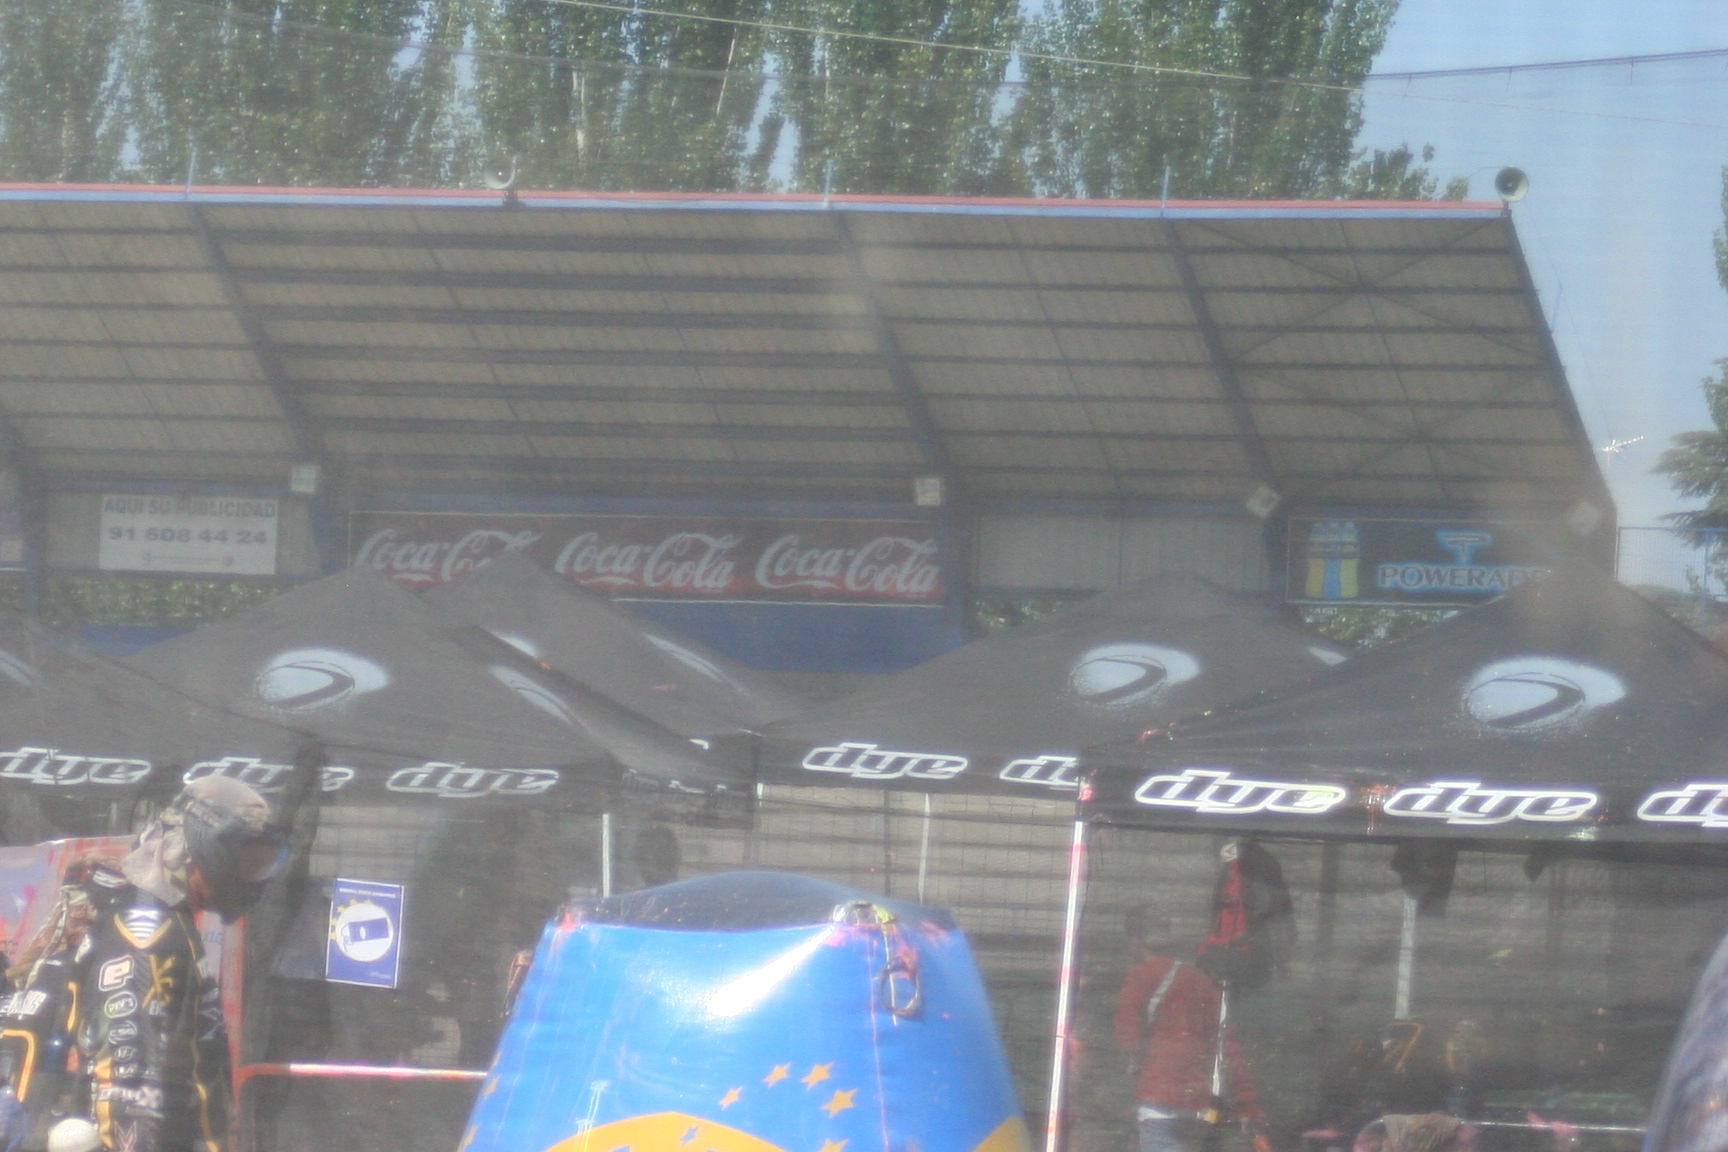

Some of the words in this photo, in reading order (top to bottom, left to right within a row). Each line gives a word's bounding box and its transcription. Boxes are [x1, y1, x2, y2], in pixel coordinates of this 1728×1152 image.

[108, 526, 136, 541] 91
[144, 527, 191, 543] 608
[198, 529, 228, 544] 44
[235, 530, 268, 545] 24
[754, 534, 942, 594] Coca-Cola
[385, 761, 560, 799] dye
[802, 742, 968, 780] dye
[1134, 769, 1347, 814] dye
[1383, 781, 1598, 825] dye
